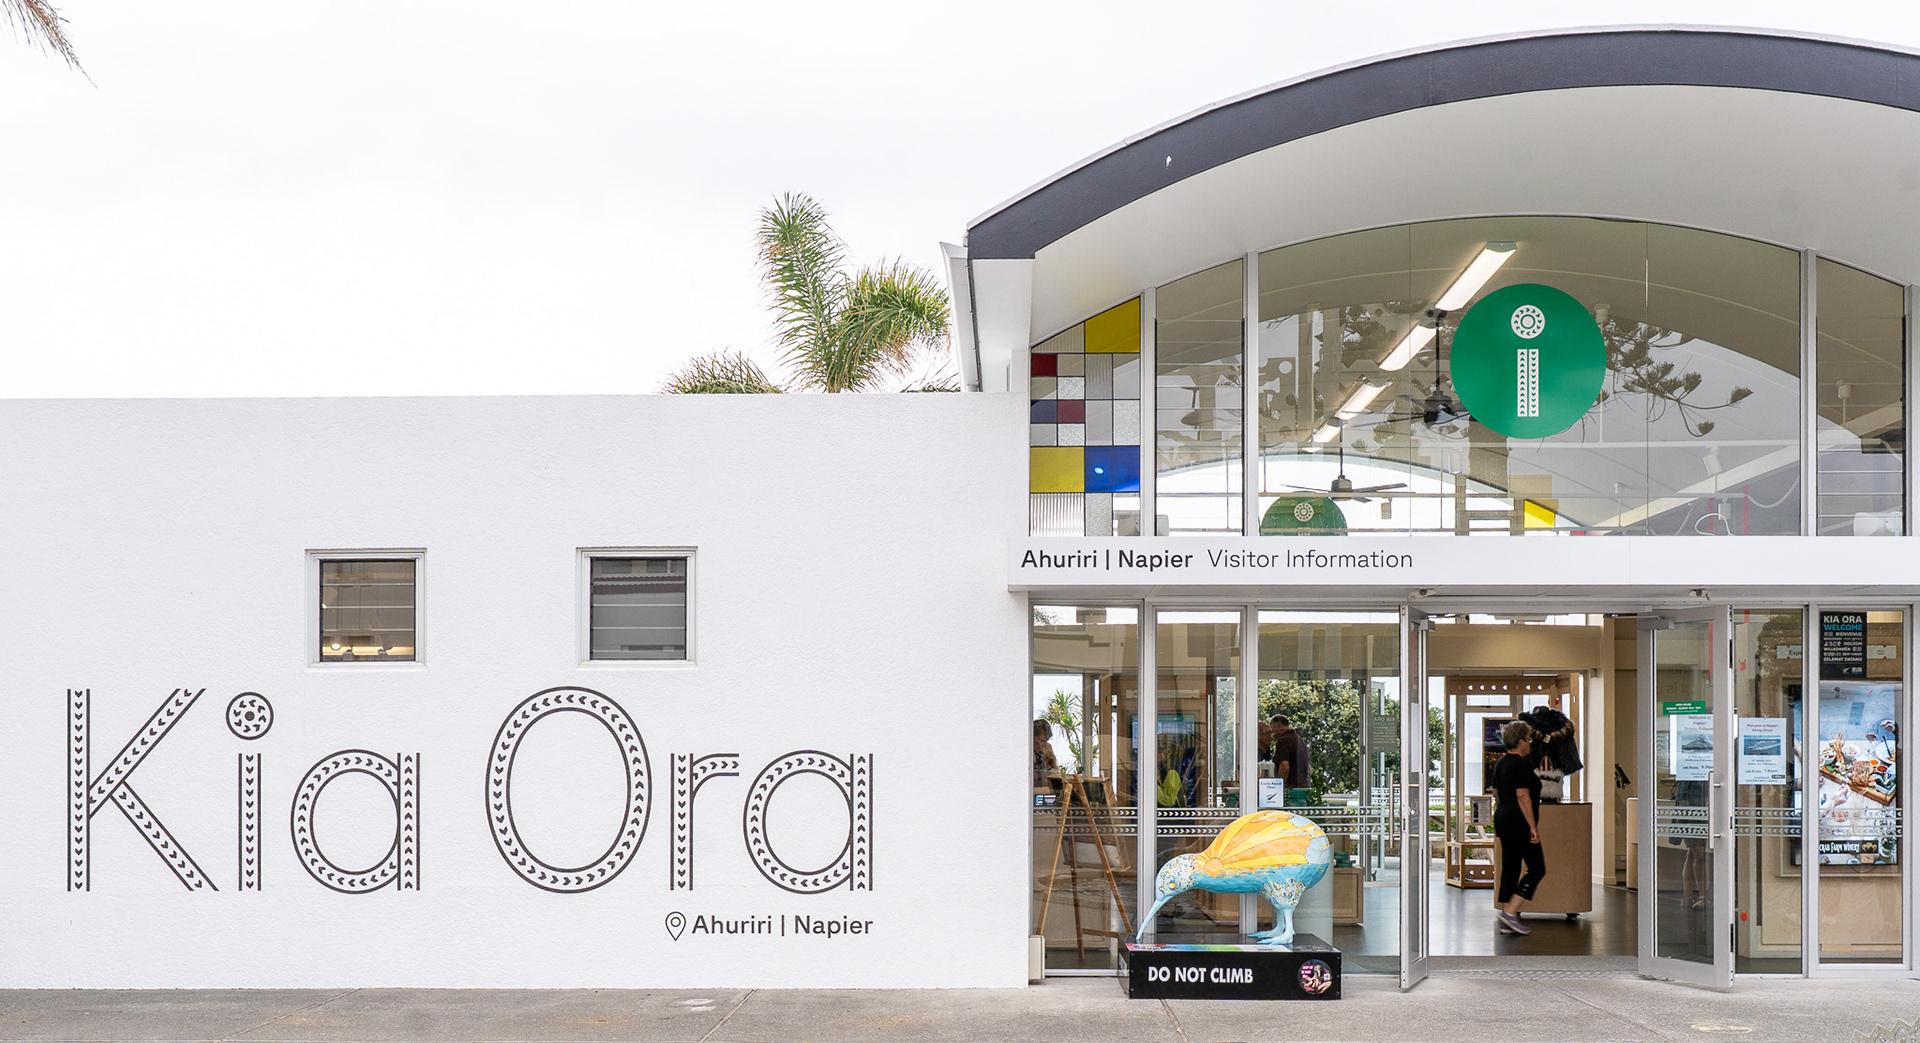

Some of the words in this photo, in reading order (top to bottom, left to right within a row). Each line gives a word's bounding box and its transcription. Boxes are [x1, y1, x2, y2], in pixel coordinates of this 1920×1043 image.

[1021, 549, 1097, 568] Ahuriri
[1118, 549, 1193, 572] Napier
[1207, 549, 1279, 568] Visitor
[1287, 549, 1413, 568] Information
[1823, 615, 1840, 623] KIA
[1842, 615, 1862, 623] ORA
[1293, 671, 1315, 680] EXIT
[67, 687, 421, 894] Kia
[485, 686, 874, 895] Ora
[1831, 842, 1843, 853] FARM
[1843, 842, 1859, 852] WINERY
[692, 915, 772, 934] Ahuriri
[794, 915, 873, 938] Napier
[1148, 966, 1171, 982] DO
[1175, 966, 1207, 983] NOT
[1210, 967, 1254, 984] CLIMB
